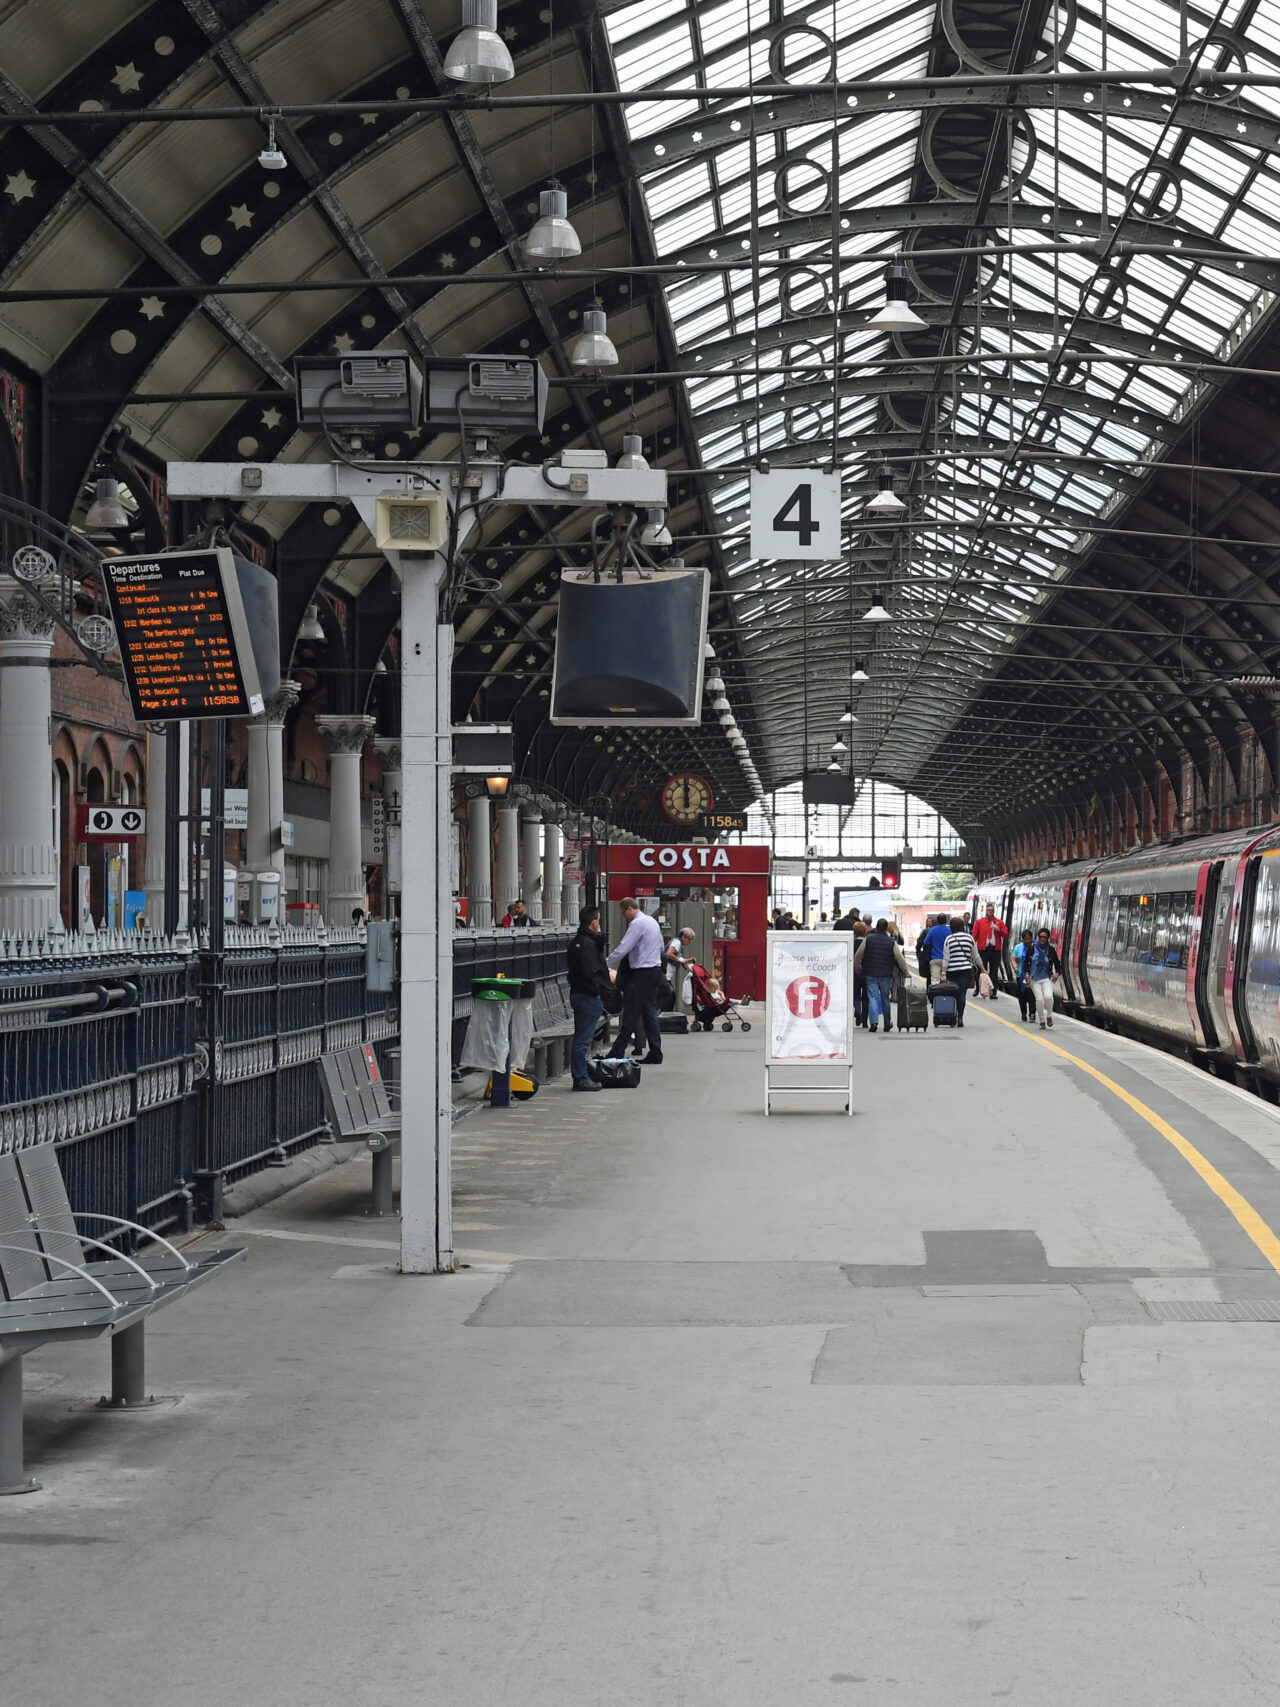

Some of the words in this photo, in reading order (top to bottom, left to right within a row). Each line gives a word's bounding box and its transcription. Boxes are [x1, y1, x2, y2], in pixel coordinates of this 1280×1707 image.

[772, 483, 820, 547] 4
[109, 563, 160, 576] Departures
[129, 573, 163, 582] Destination
[179, 570, 191, 578] Plat
[192, 569, 205, 577] Due
[135, 594, 160, 603] Newcastle
[206, 590, 218, 598] time
[146, 605, 160, 614] class
[168, 604, 176, 612] the
[177, 604, 189, 612] rear
[190, 602, 206, 611] coach
[139, 618, 163, 627] Aberdeen
[163, 617, 172, 625] via
[155, 628, 178, 637] Northern
[144, 640, 169, 649] Catterick
[169, 639, 185, 648] Tesco
[195, 638, 204, 647] Bus
[208, 636, 217, 645] On
[216, 636, 228, 644] time
[147, 652, 165, 661] London
[165, 651, 179, 661] Kings
[211, 648, 219, 657] On
[219, 647, 231, 656] time
[149, 663, 172, 672] Saltburn
[172, 662, 181, 671] via
[213, 658, 233, 668] Arrived
[151, 675, 175, 684] Liverpool
[216, 671, 224, 680] On
[224, 670, 236, 679] time
[154, 686, 180, 695] Newcastle
[218, 683, 226, 692] On
[226, 682, 238, 691] time
[141, 699, 160, 709] Page
[162, 698, 168, 707] 2
[170, 698, 179, 706] of
[181, 697, 187, 706] 2
[638, 847, 730, 870] COSTA
[807, 847, 815, 857] 4
[777, 953, 805, 963] Please
[807, 954, 826, 962] wait
[778, 963, 797, 972] here
[798, 963, 810, 973] for
[812, 962, 837, 973] Coach
